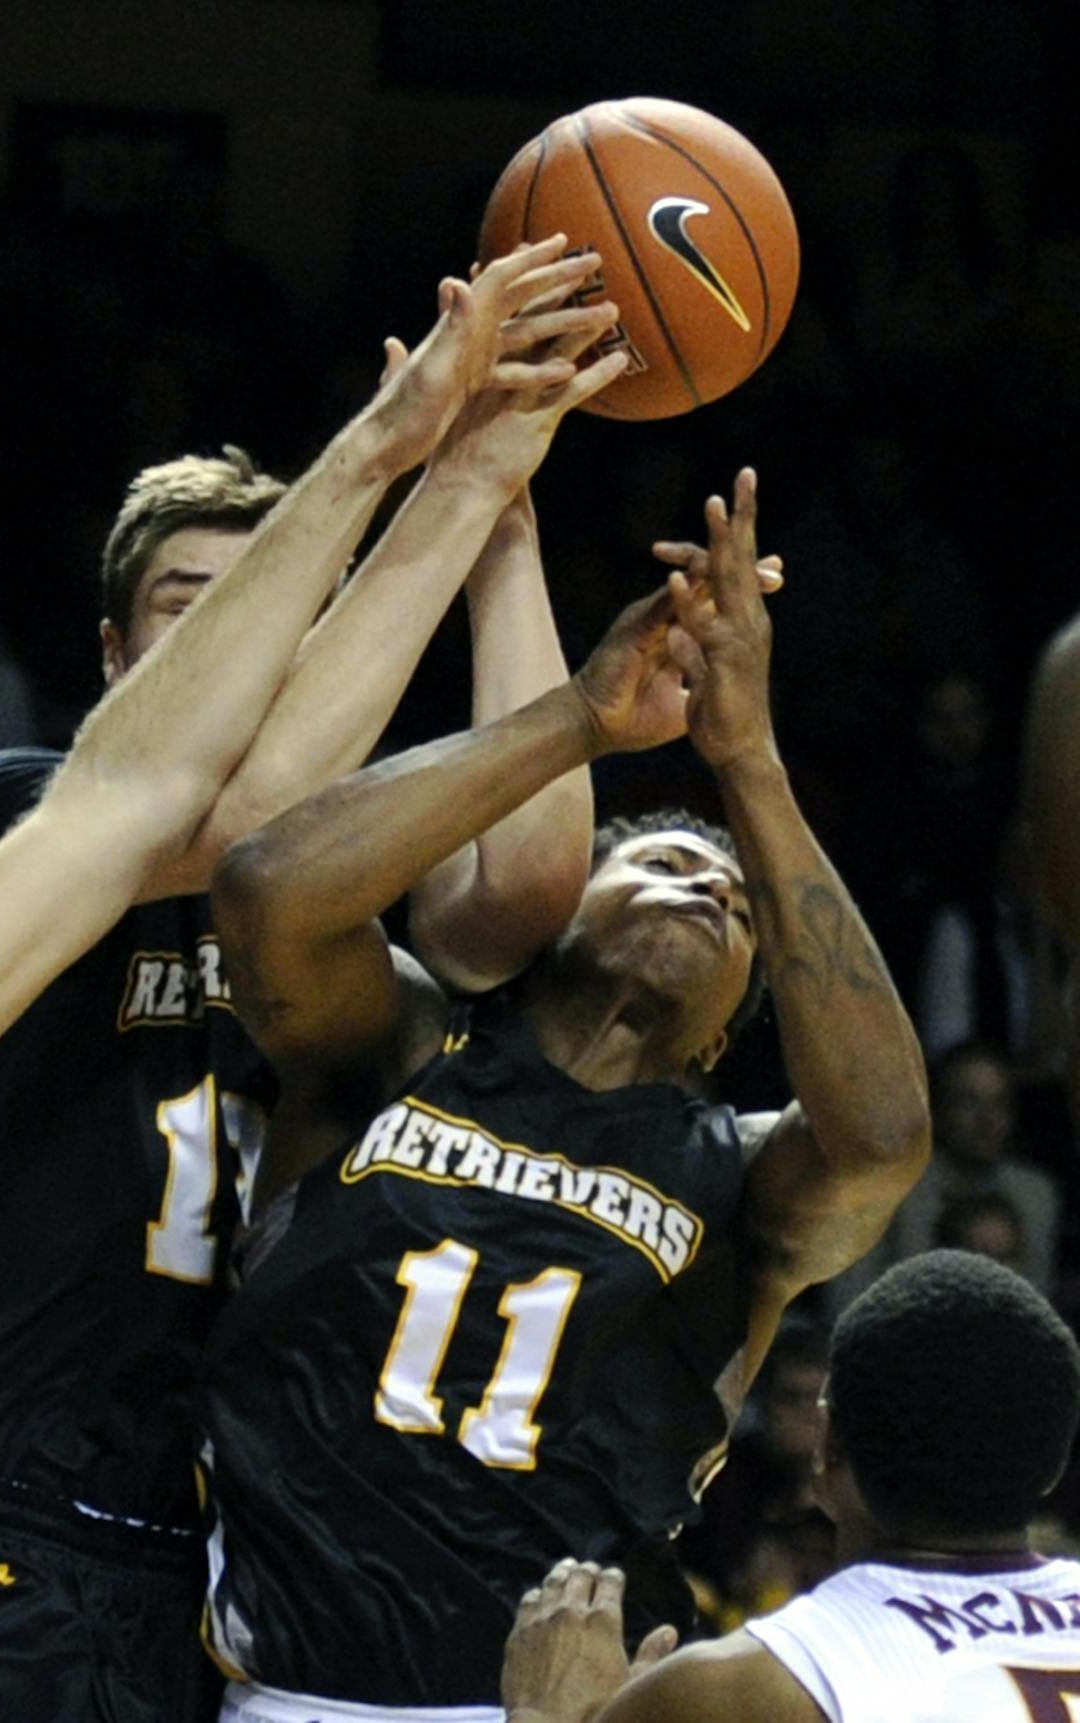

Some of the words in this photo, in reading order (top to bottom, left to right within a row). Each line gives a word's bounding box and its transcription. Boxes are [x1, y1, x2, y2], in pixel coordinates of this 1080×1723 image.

[145, 1072, 256, 1287] 1
[346, 1099, 700, 1279] RETRIEVERS
[374, 1238, 583, 1470] 11
